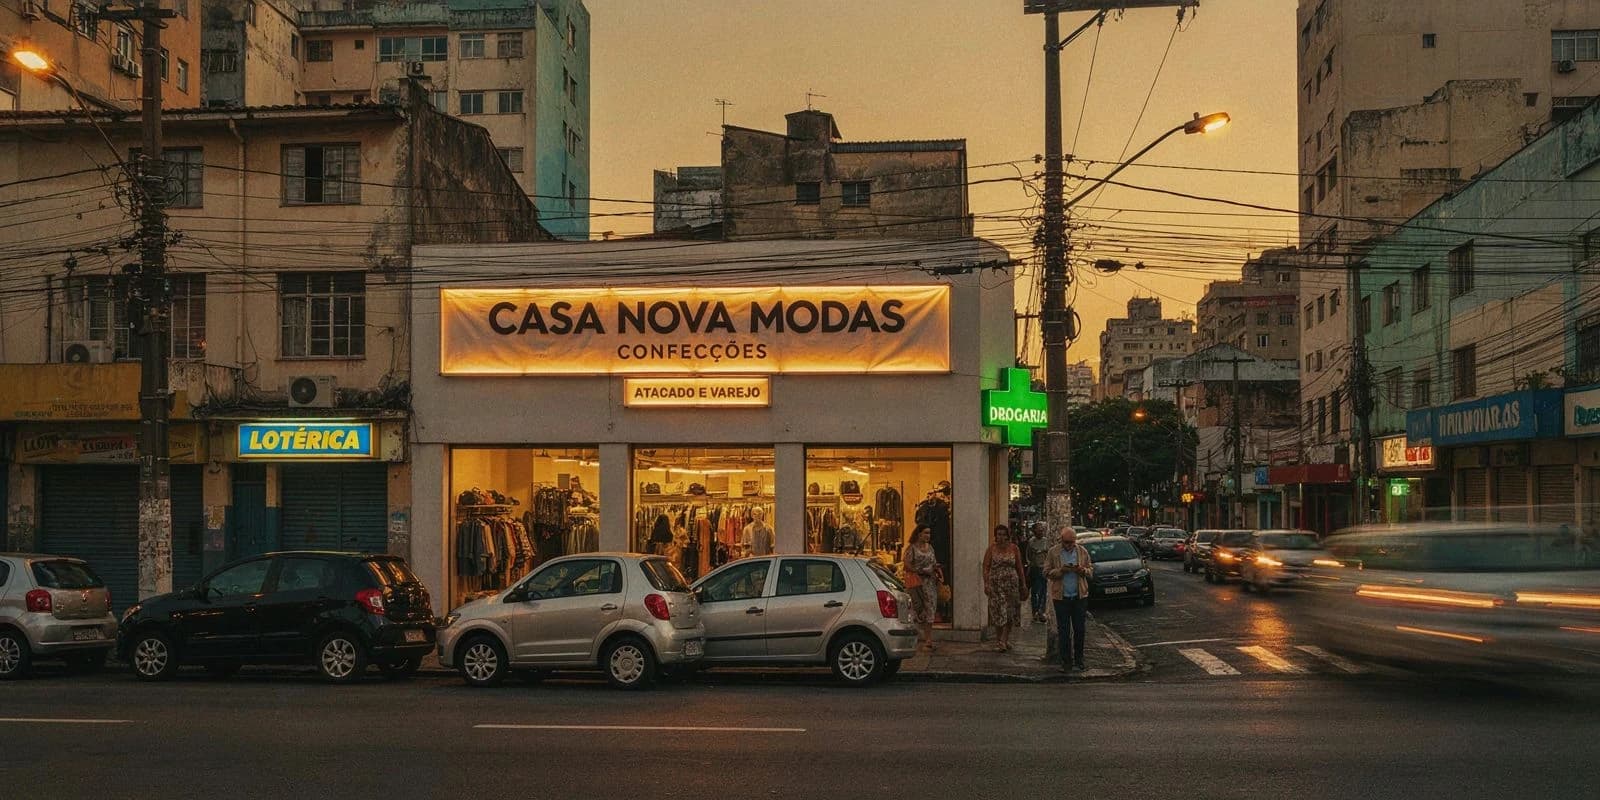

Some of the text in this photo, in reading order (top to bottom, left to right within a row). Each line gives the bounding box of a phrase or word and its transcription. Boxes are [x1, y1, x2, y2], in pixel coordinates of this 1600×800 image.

[488, 300, 905, 335] CASA NOVA MODAS
[618, 341, 767, 362] CONFECÇÕES
[634, 387, 760, 398] ATACADO E VAREJO
[990, 407, 1048, 423] DROGARIA
[249, 427, 360, 450] LOTÉRICA
